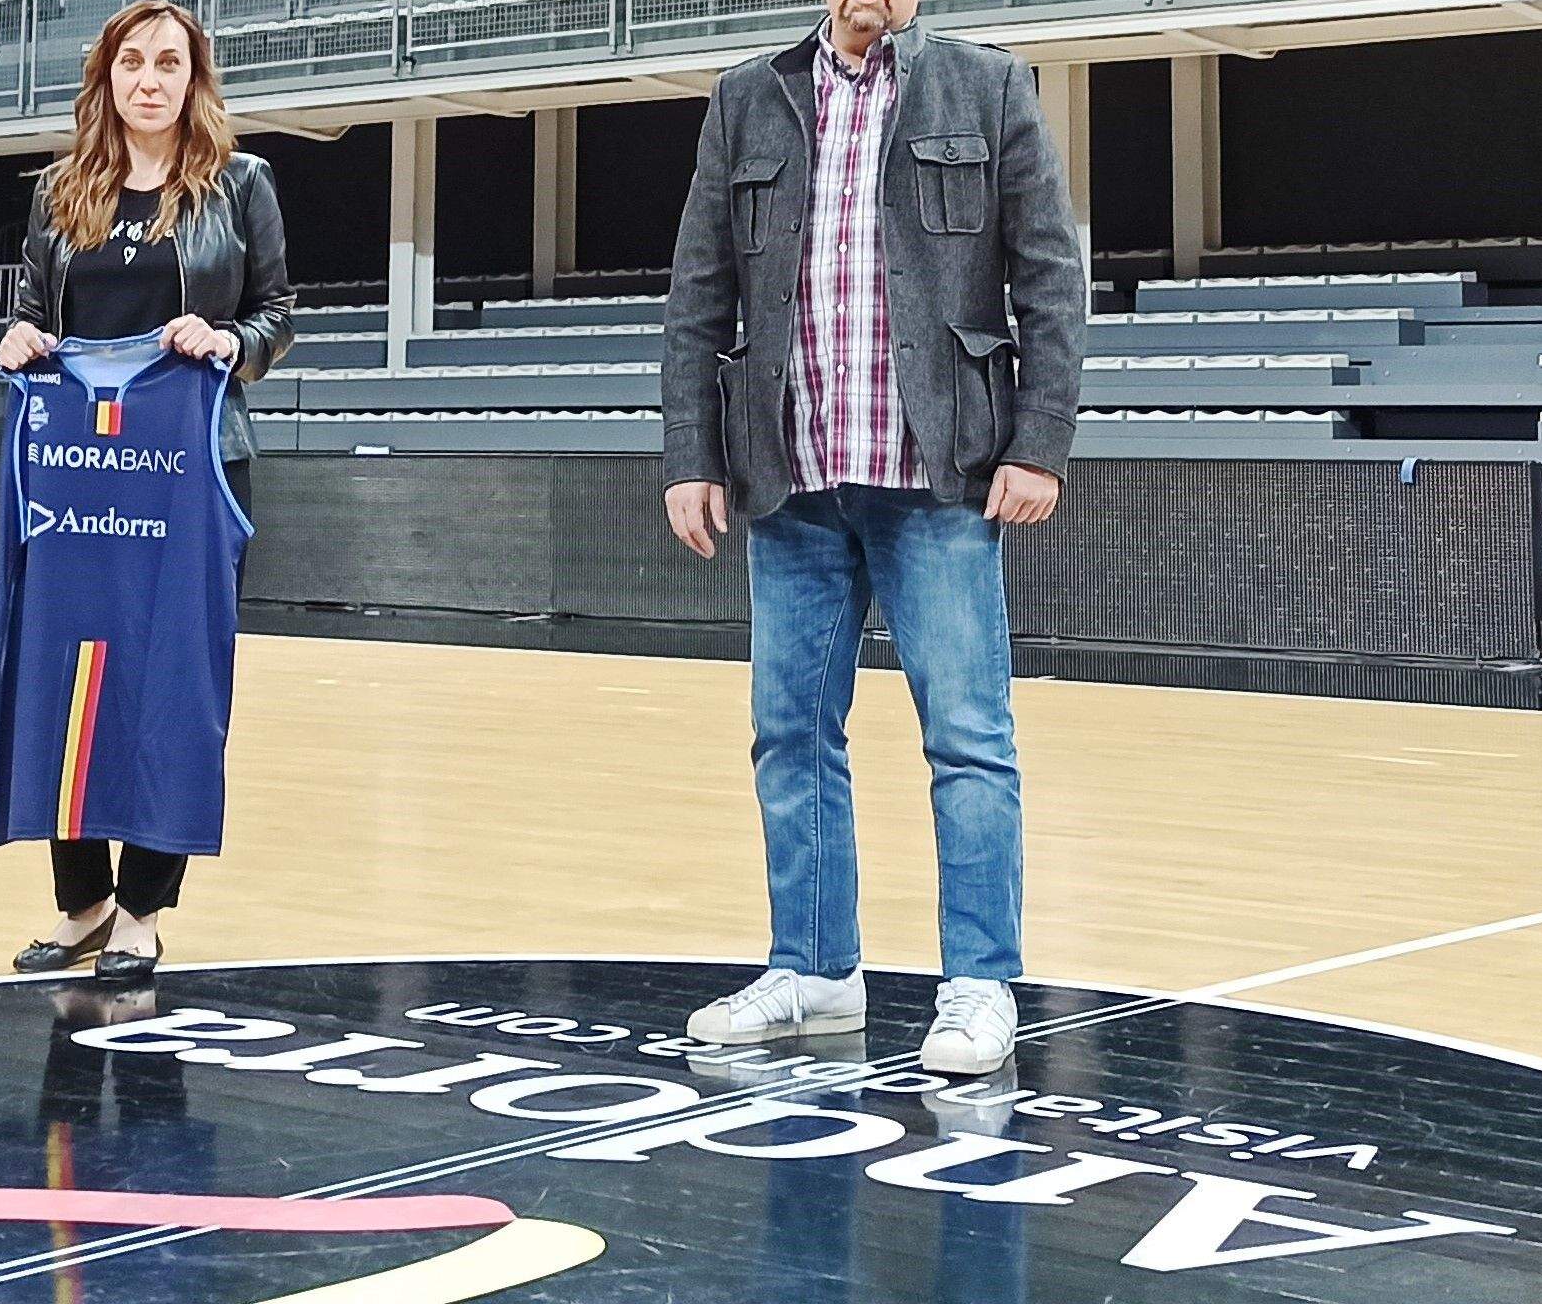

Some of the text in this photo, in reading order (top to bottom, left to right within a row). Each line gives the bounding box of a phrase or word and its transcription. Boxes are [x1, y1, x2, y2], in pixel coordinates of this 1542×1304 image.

[42, 444, 186, 475] MORABANC
[56, 506, 167, 538] Andorra
[404, 1001, 1380, 1171] visitandorra.com
[69, 1007, 1518, 1272] Andorra
